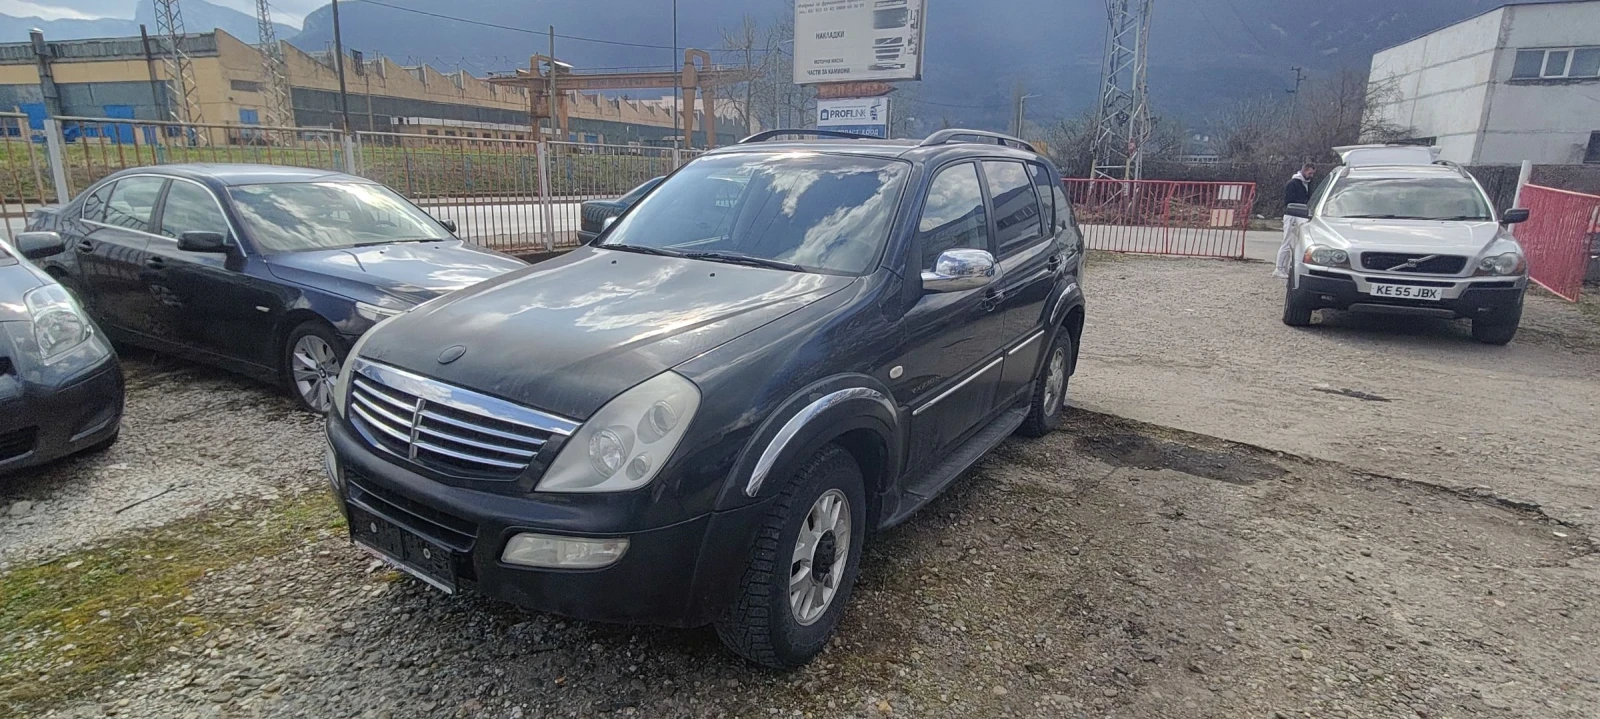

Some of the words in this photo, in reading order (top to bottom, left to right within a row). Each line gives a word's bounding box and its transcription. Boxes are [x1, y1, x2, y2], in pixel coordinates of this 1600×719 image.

[815, 31, 845, 40] НАКЛАДКИ
[1376, 285, 1393, 295] KE
[1395, 287, 1412, 296] 55
[1413, 289, 1438, 298] JBX
